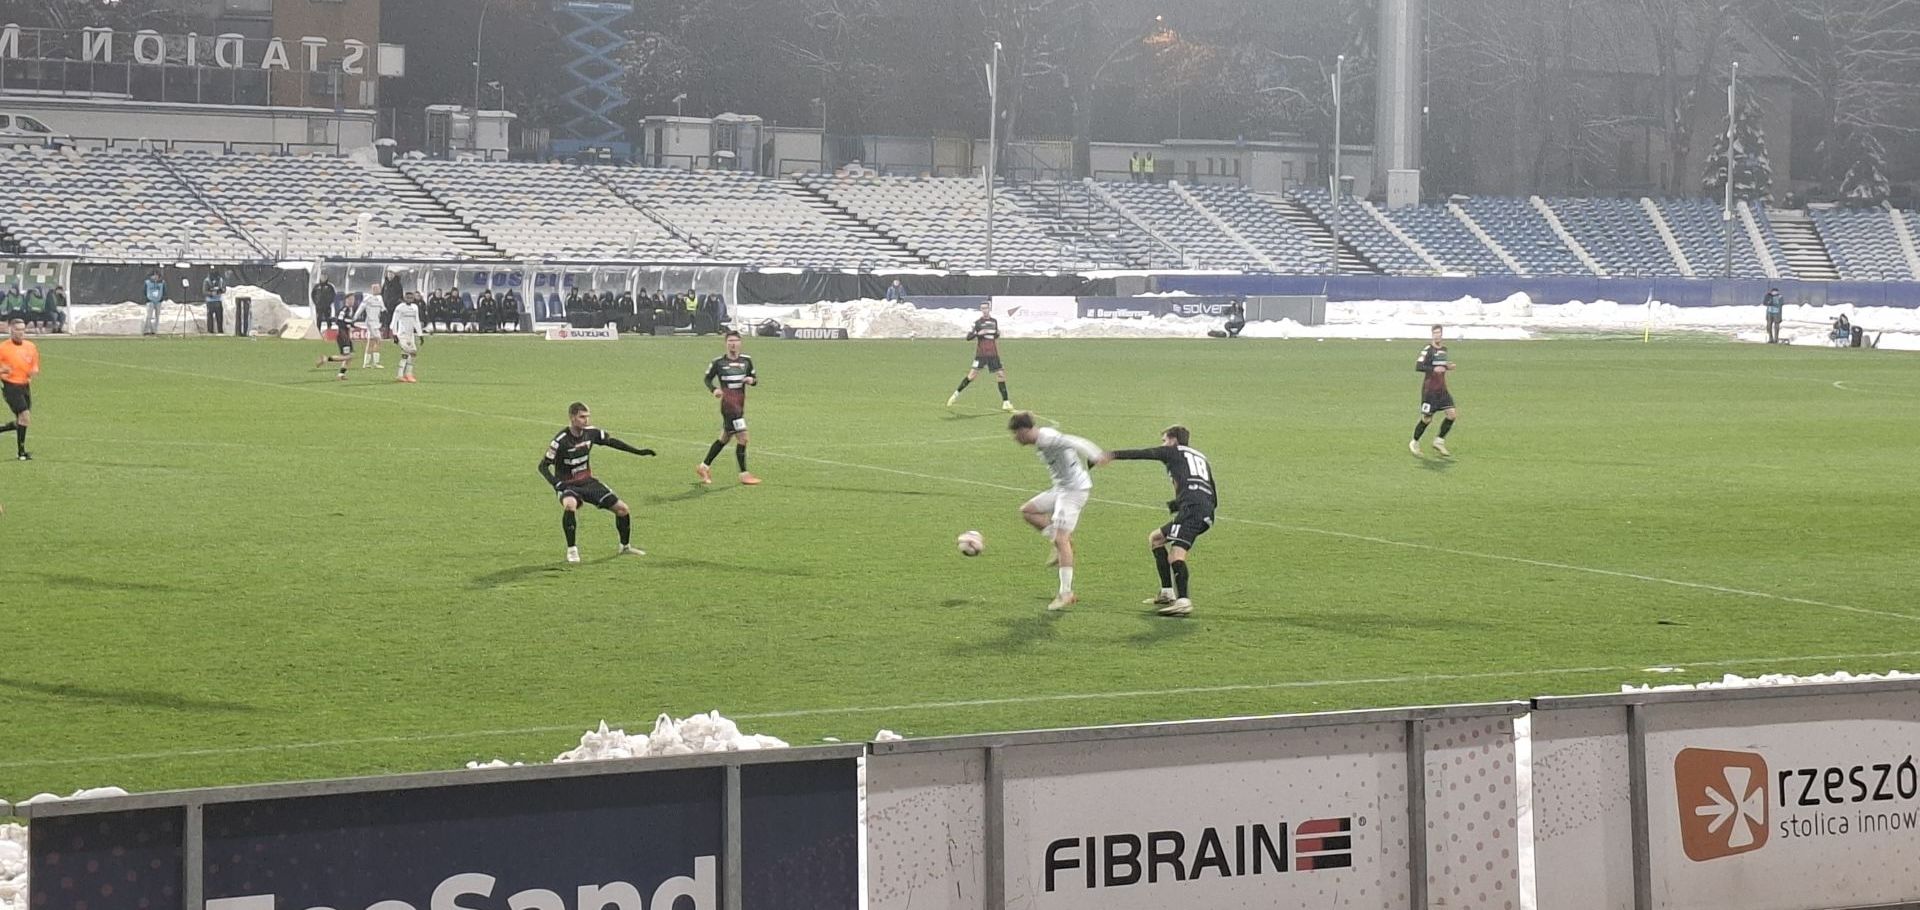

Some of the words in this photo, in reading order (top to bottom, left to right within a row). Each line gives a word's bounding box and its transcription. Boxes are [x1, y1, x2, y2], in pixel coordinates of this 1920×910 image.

[570, 330, 610, 338] SUZUKI
[1778, 754, 1917, 807] rzeszó
[1780, 810, 1849, 838] stolica
[1858, 809, 1918, 833] innow
[1045, 821, 1289, 892] FIBRAIN
